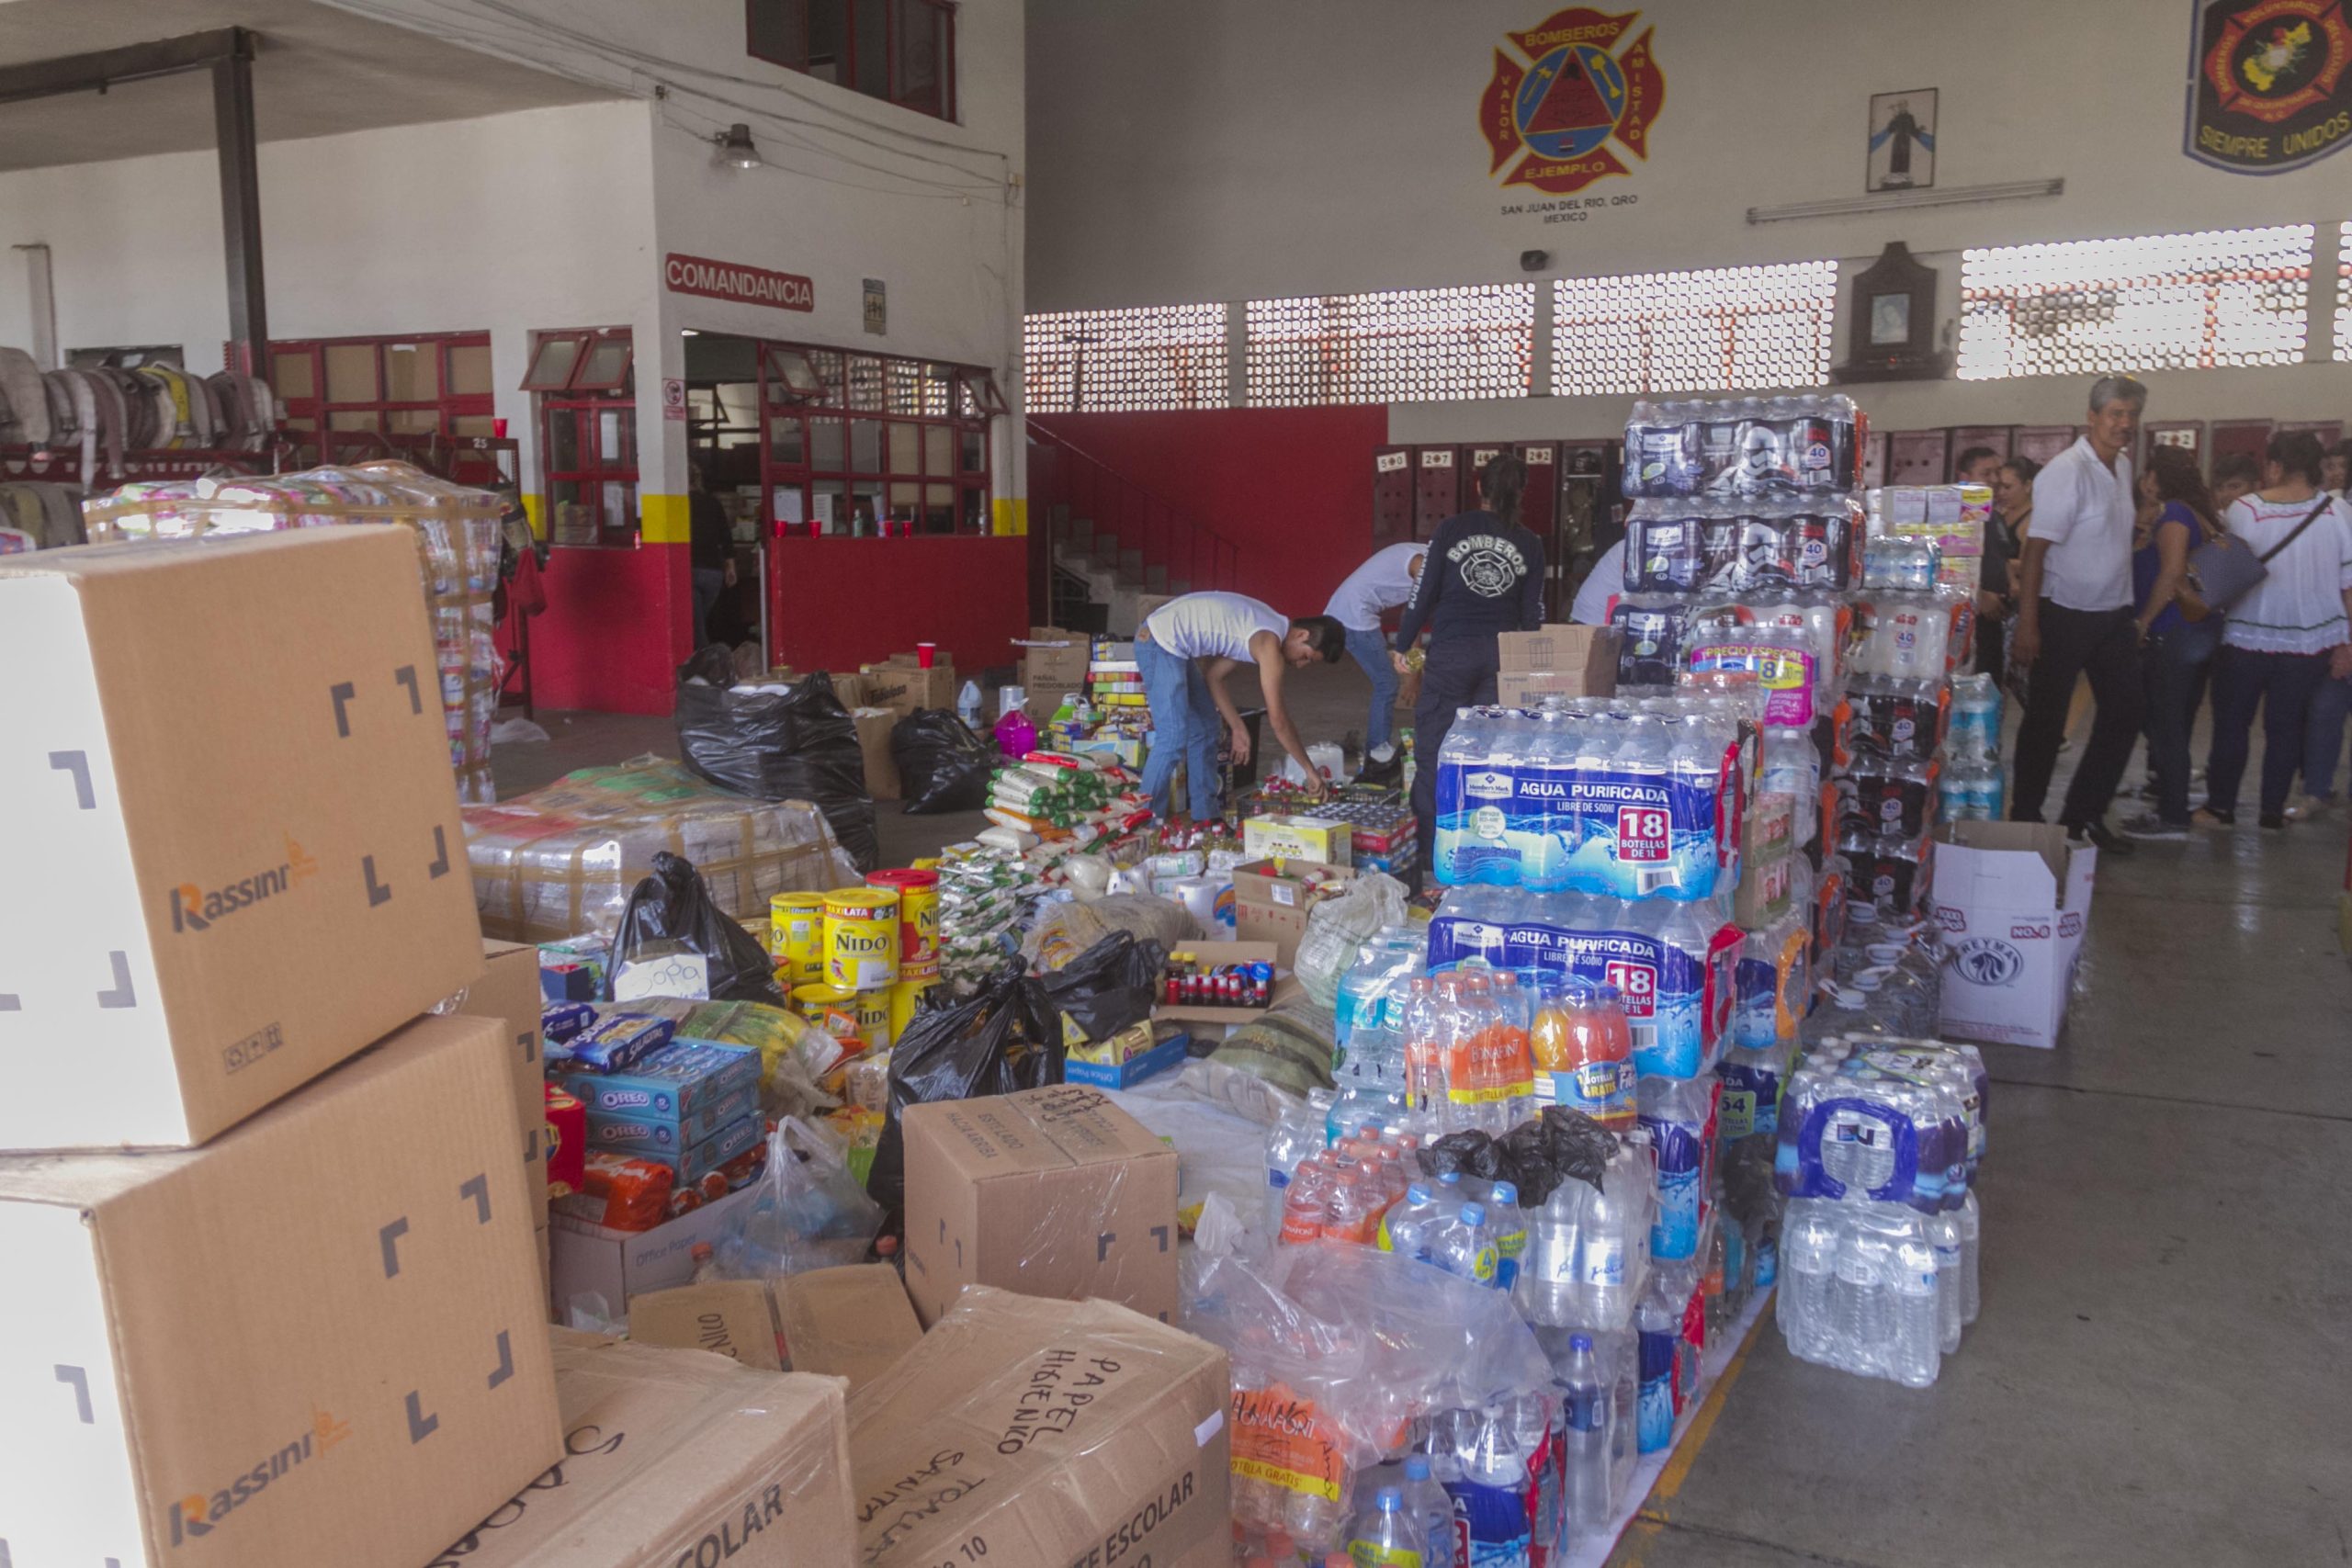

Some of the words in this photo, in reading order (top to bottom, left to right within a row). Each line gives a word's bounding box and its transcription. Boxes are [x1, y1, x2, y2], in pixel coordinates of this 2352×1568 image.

[1524, 22, 1620, 47] BOMBEROS
[1629, 43, 1645, 140] AMISTAD
[1499, 75, 1510, 141] VALOR
[2282, 110, 2352, 155] UNIDOS
[1524, 161, 1606, 179] EJEMPLO
[1500, 204, 1523, 216] SAN
[1525, 202, 1556, 213] JUAN
[1558, 199, 1581, 210] DEL
[1611, 194, 1638, 206] QRO
[1544, 211, 1588, 224] MEXICO
[666, 260, 813, 306] COMANDANCIA
[1808, 447, 1826, 458] 40
[1446, 533, 1529, 576] BOMBEROS
[1805, 544, 1823, 554] 40
[1897, 632, 1914, 642] 40
[1761, 660, 1777, 680] 8
[1519, 781, 1566, 797] AGUA
[1571, 784, 1669, 804] PURIFICADA
[1557, 801, 1581, 812] LIBRE
[1583, 802, 1593, 812] DE
[1594, 803, 1615, 813] SODIO
[1622, 812, 1665, 838] 18
[1621, 839, 1667, 850] BOTELLAS
[1631, 848, 1645, 857] DE
[1646, 849, 1657, 858] 1L
[169, 862, 292, 933] Rassini
[835, 933, 888, 952] NIDO
[1509, 930, 1552, 946] AGUA
[1557, 936, 1656, 959] PURIFICADA
[1961, 938, 2014, 961] REYMA
[1544, 951, 1567, 964] LIBRE
[1569, 953, 1580, 964] DE
[1581, 954, 1603, 966] SODIO
[1610, 967, 1652, 995] 18
[1618, 995, 1652, 1007] TELLAS
[1633, 1005, 1643, 1014] 1L
[602, 1090, 649, 1110] OREO
[1583, 1080, 1617, 1099] GRATIS
[602, 1123, 649, 1143] OREO
[635, 1247, 667, 1268] Office
[1027, 1355, 1122, 1444] PAPEL
[167, 1424, 318, 1549] Rassini
[1265, 1467, 1300, 1488] GRATIS
[1105, 1471, 1194, 1561] ESCOLAR
[959, 1535, 988, 1562] 10
